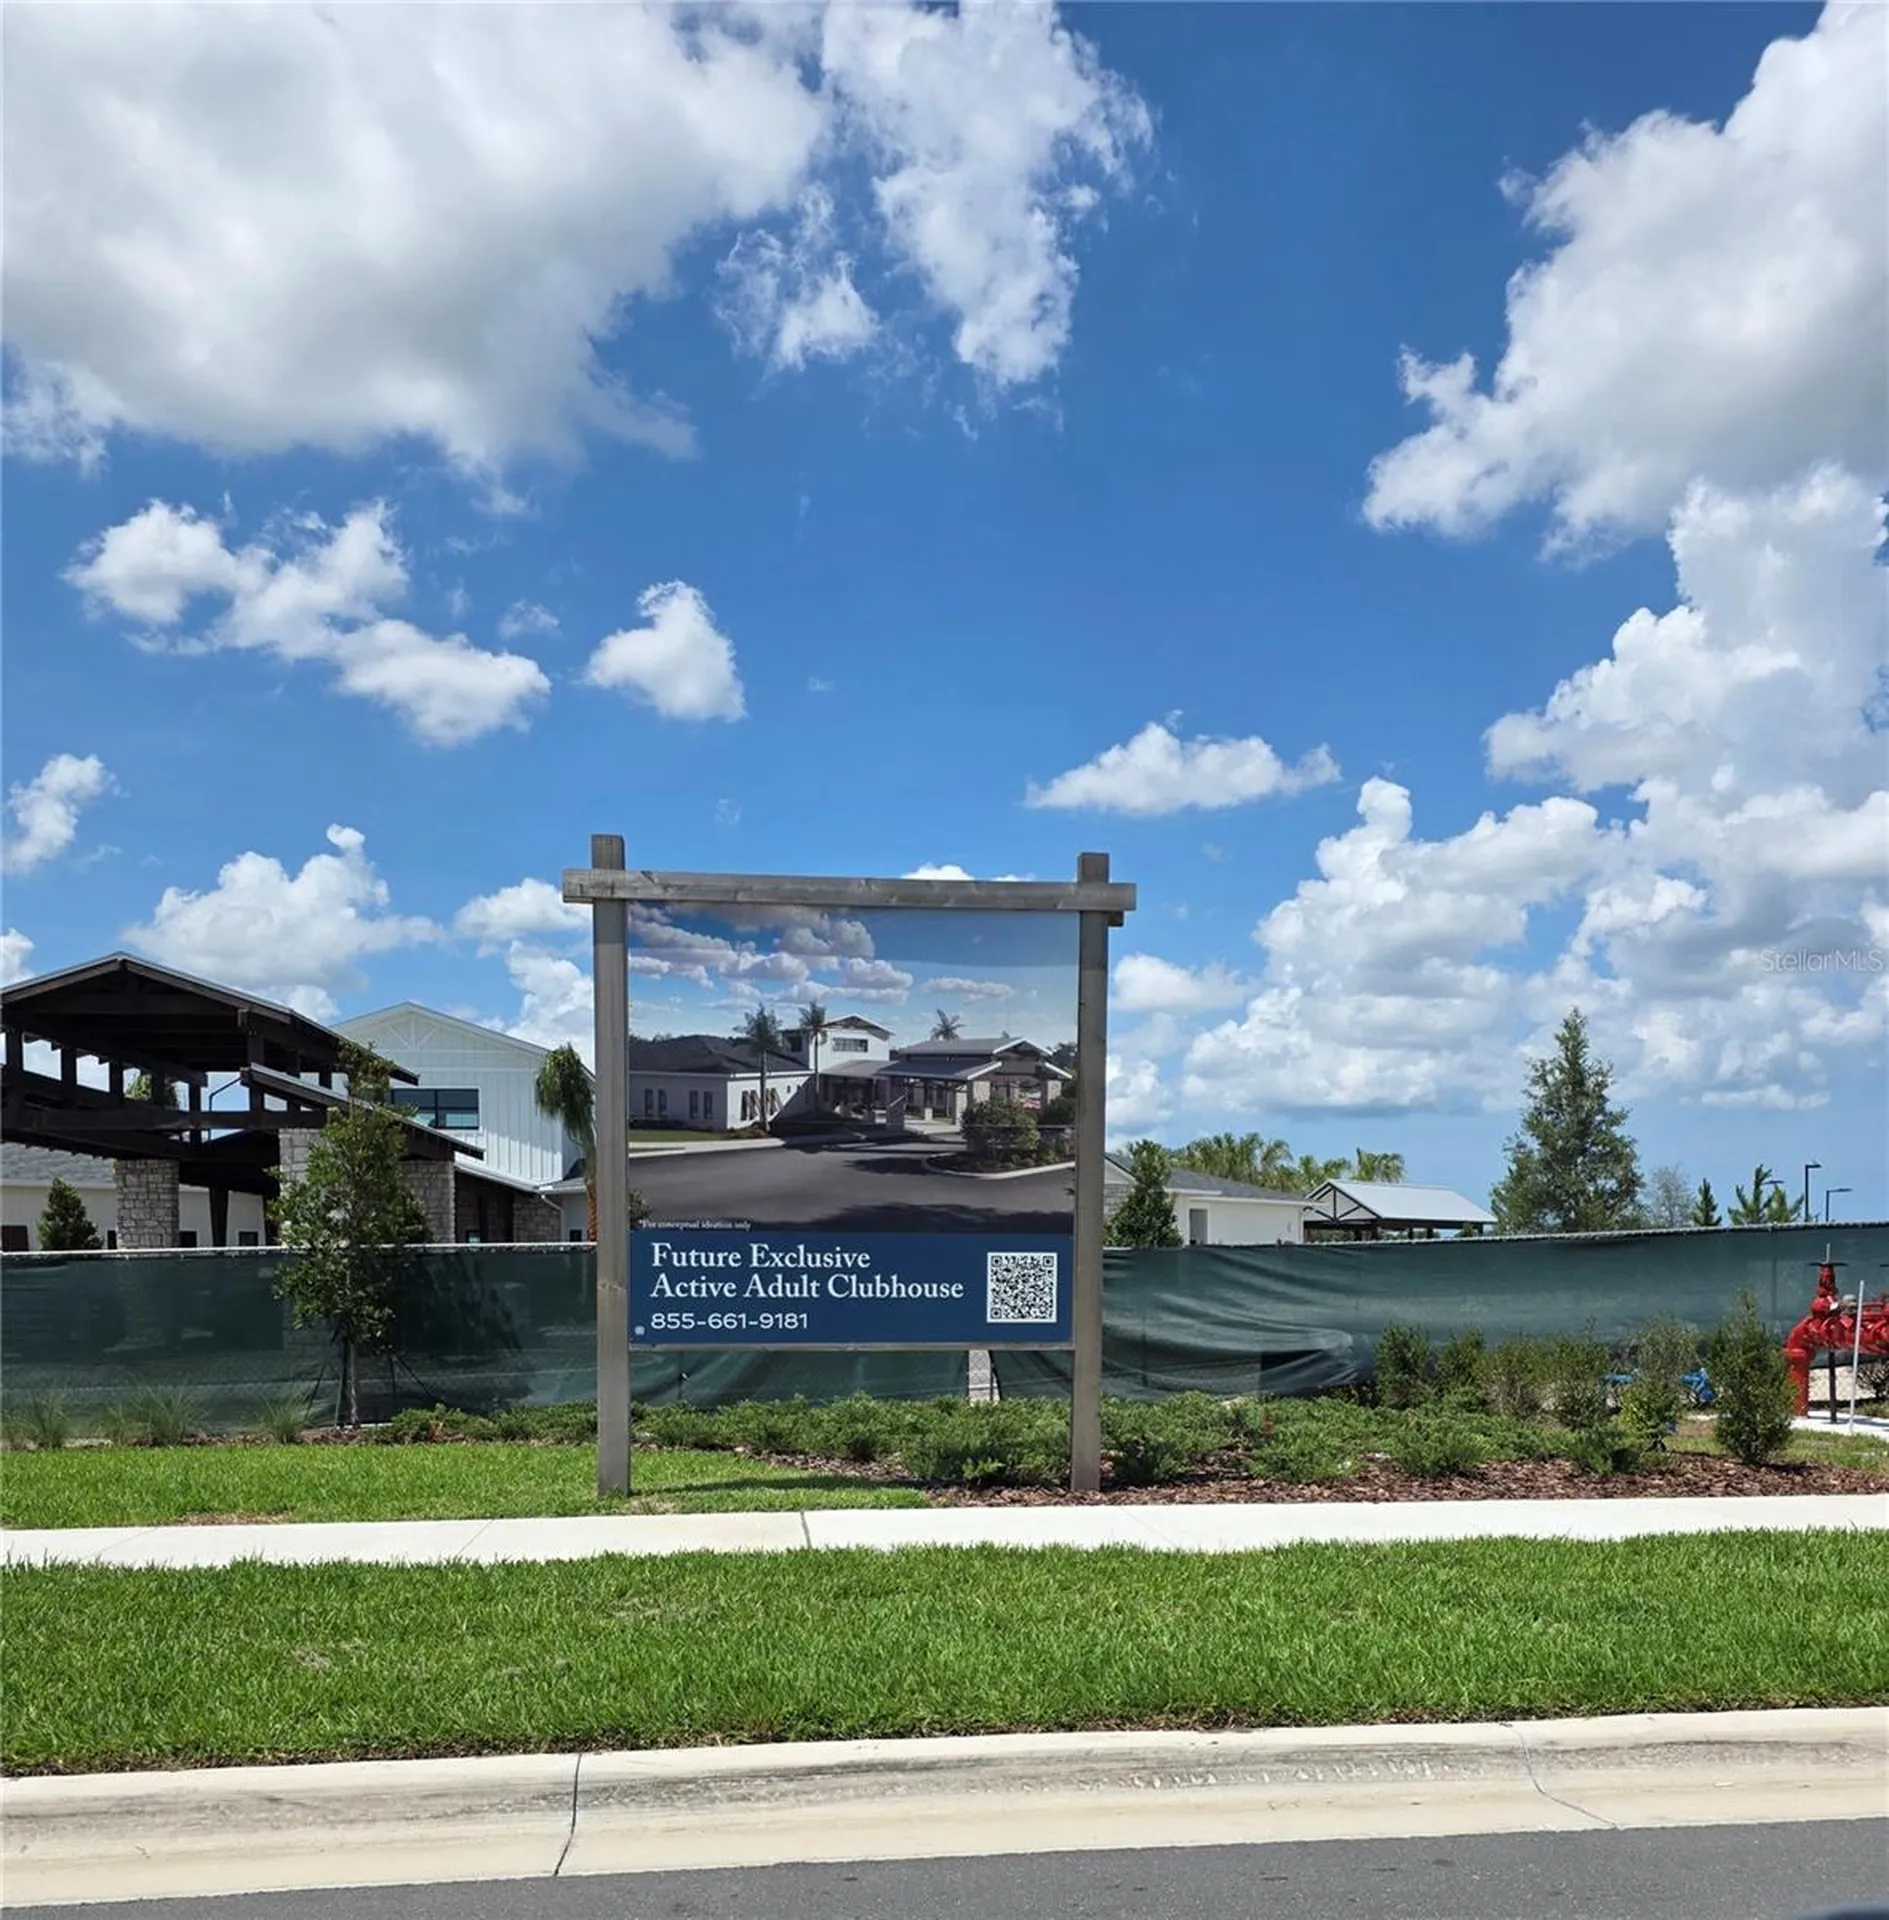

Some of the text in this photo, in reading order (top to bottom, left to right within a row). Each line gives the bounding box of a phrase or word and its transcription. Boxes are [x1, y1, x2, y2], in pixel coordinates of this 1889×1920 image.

[650, 1242, 871, 1269] Future Exclusive
[649, 1273, 965, 1300] Active Adult Clubhouse
[650, 1312, 809, 1331] 855-661-9181
